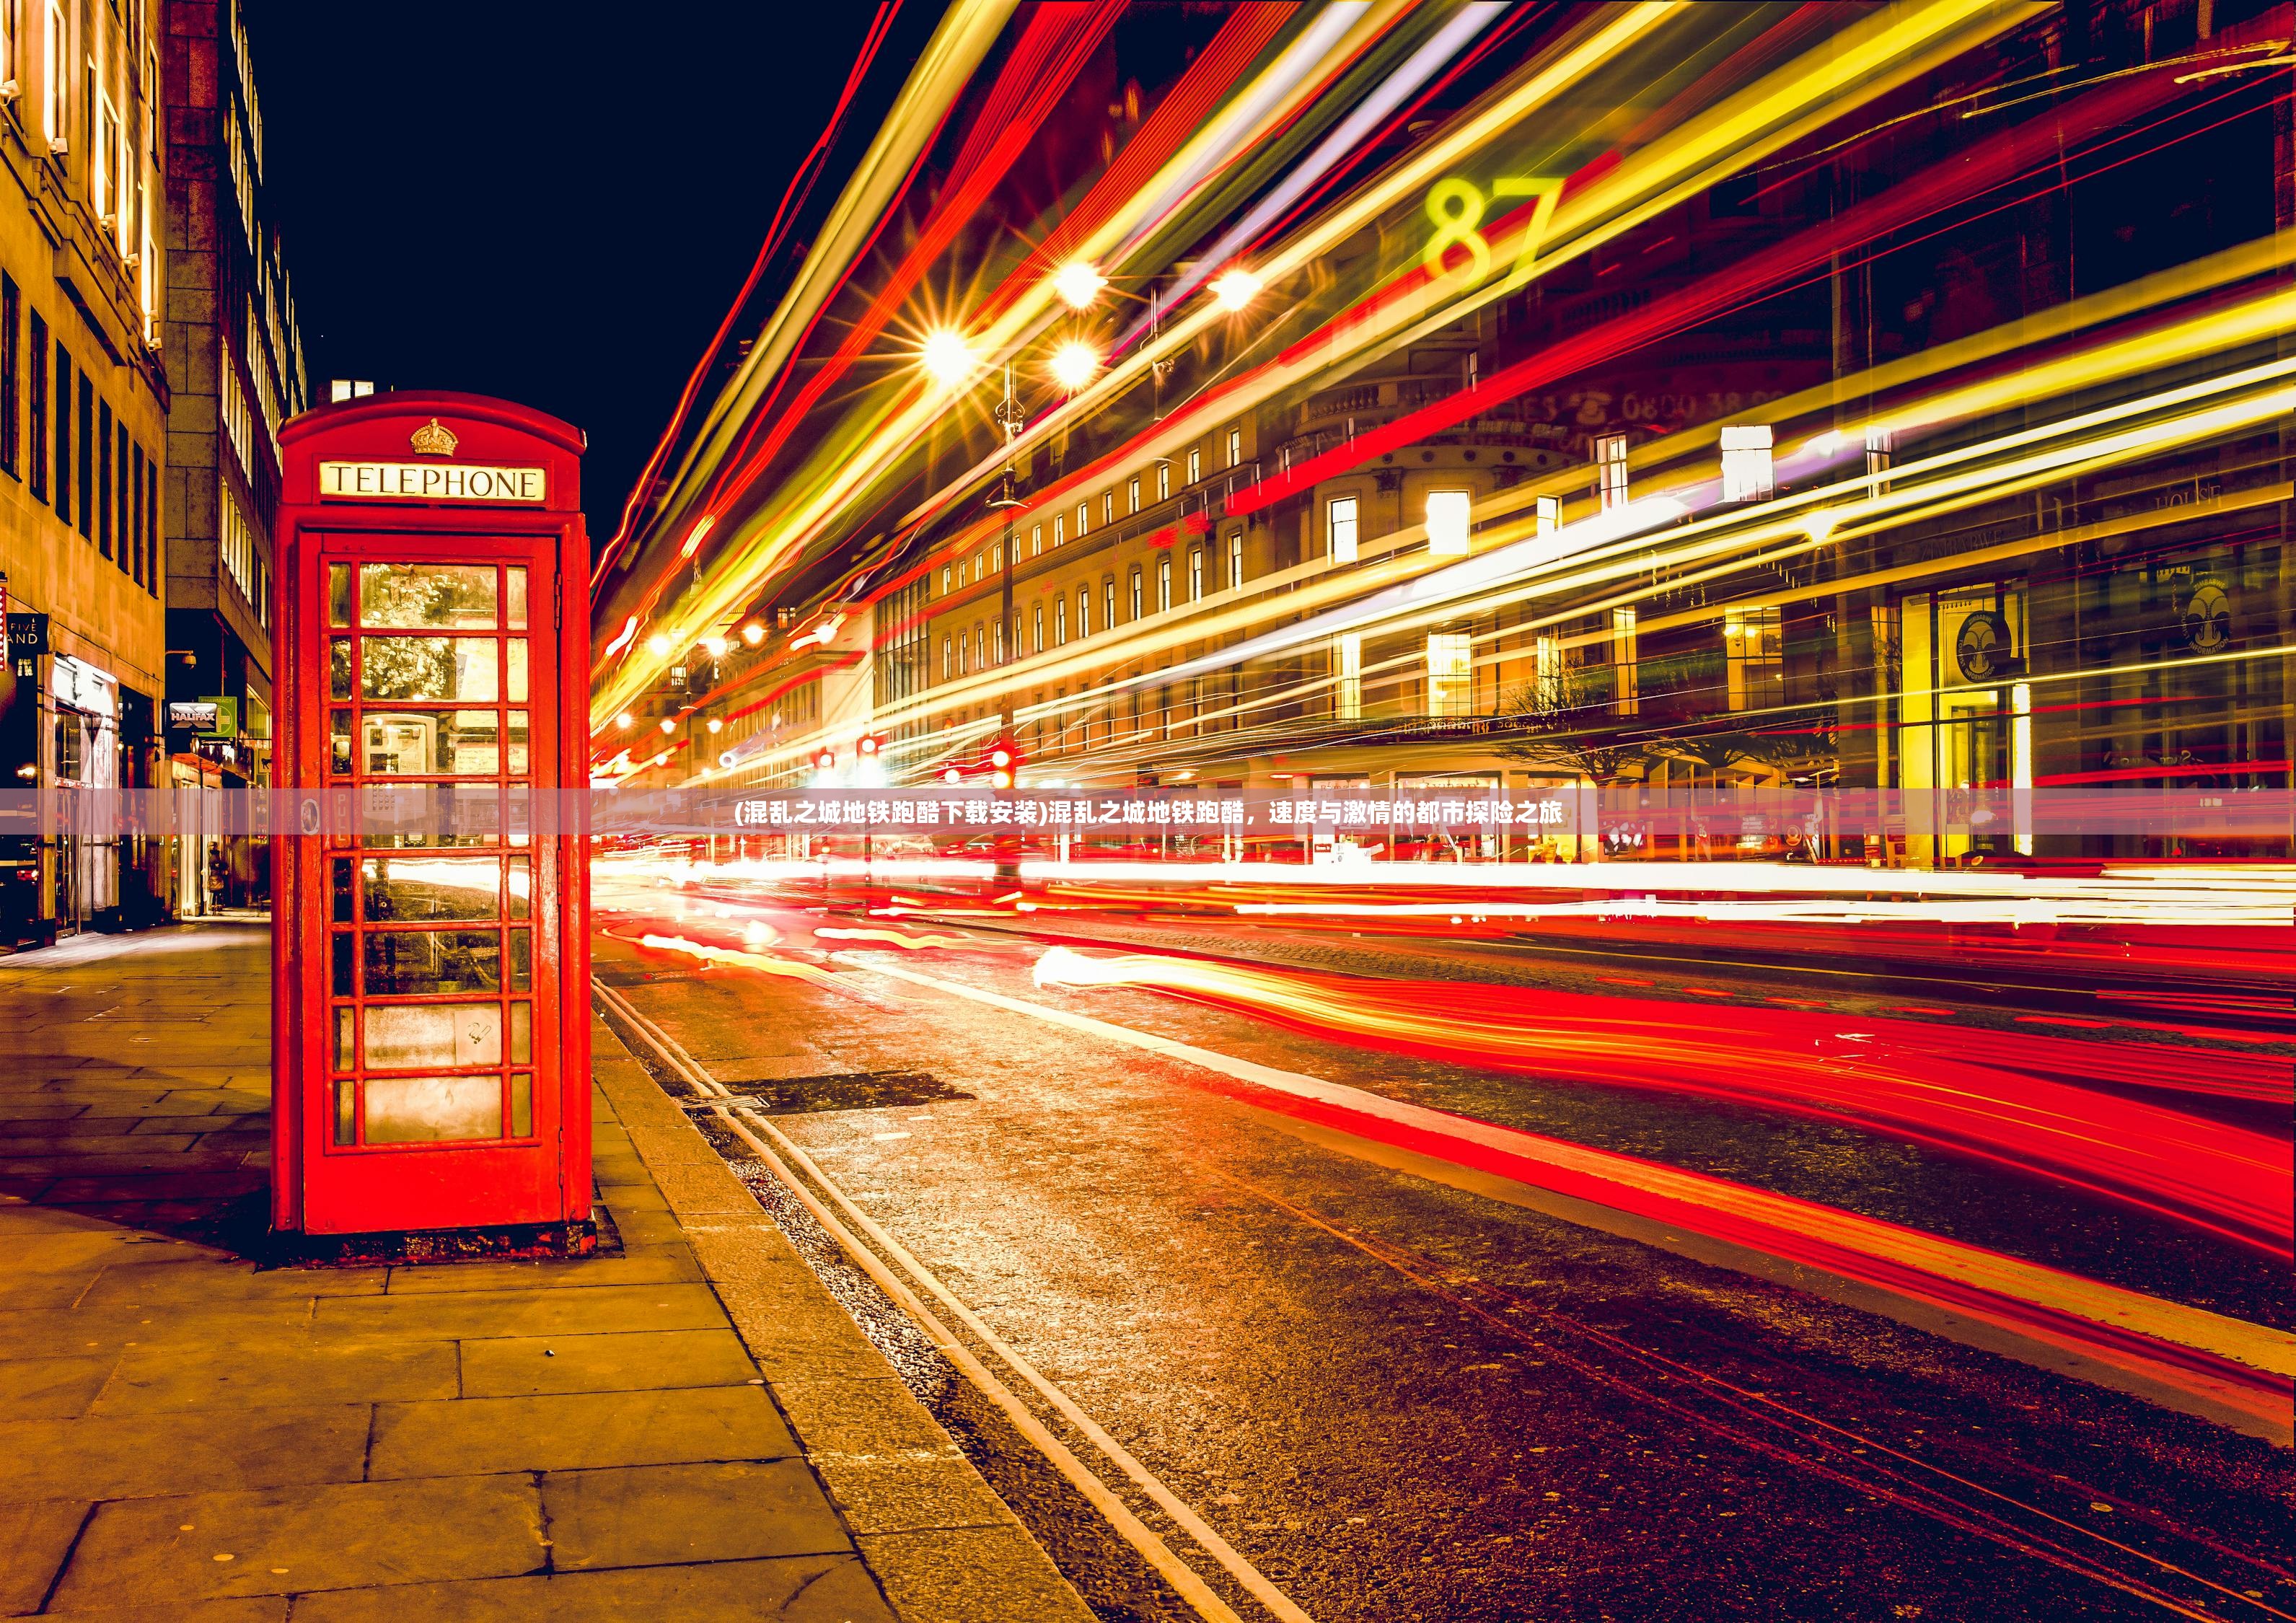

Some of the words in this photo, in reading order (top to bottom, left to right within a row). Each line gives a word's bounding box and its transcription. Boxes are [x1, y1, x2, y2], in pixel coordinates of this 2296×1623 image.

[1422, 177, 1566, 292] 87
[329, 466, 537, 498] TELEPHONE
[2194, 579, 2226, 591] ZIMBABWE
[2189, 636, 2230, 655] INFORMATION
[1964, 664, 1996, 680] INFORMATION
[171, 713, 216, 721] HALIFAX
[338, 793, 346, 841] PULL
